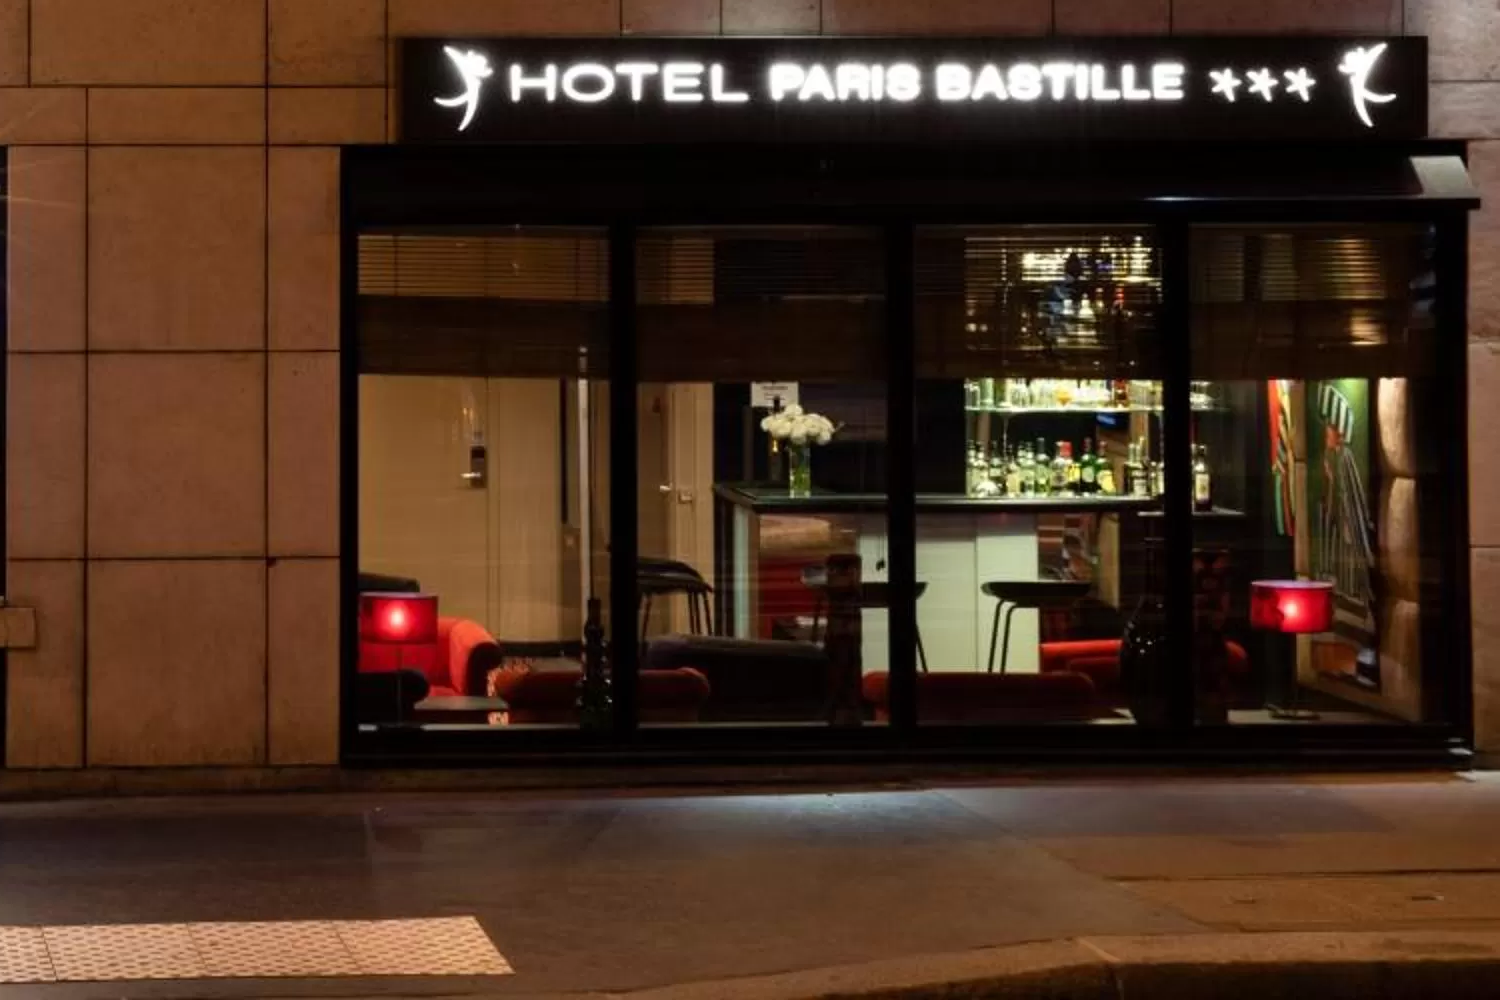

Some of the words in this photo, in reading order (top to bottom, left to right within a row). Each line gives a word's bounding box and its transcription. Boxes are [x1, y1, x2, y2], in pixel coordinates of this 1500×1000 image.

[508, 61, 750, 103] HOTEL
[767, 60, 924, 103] PARIS
[934, 60, 1186, 103] BASTILLE
